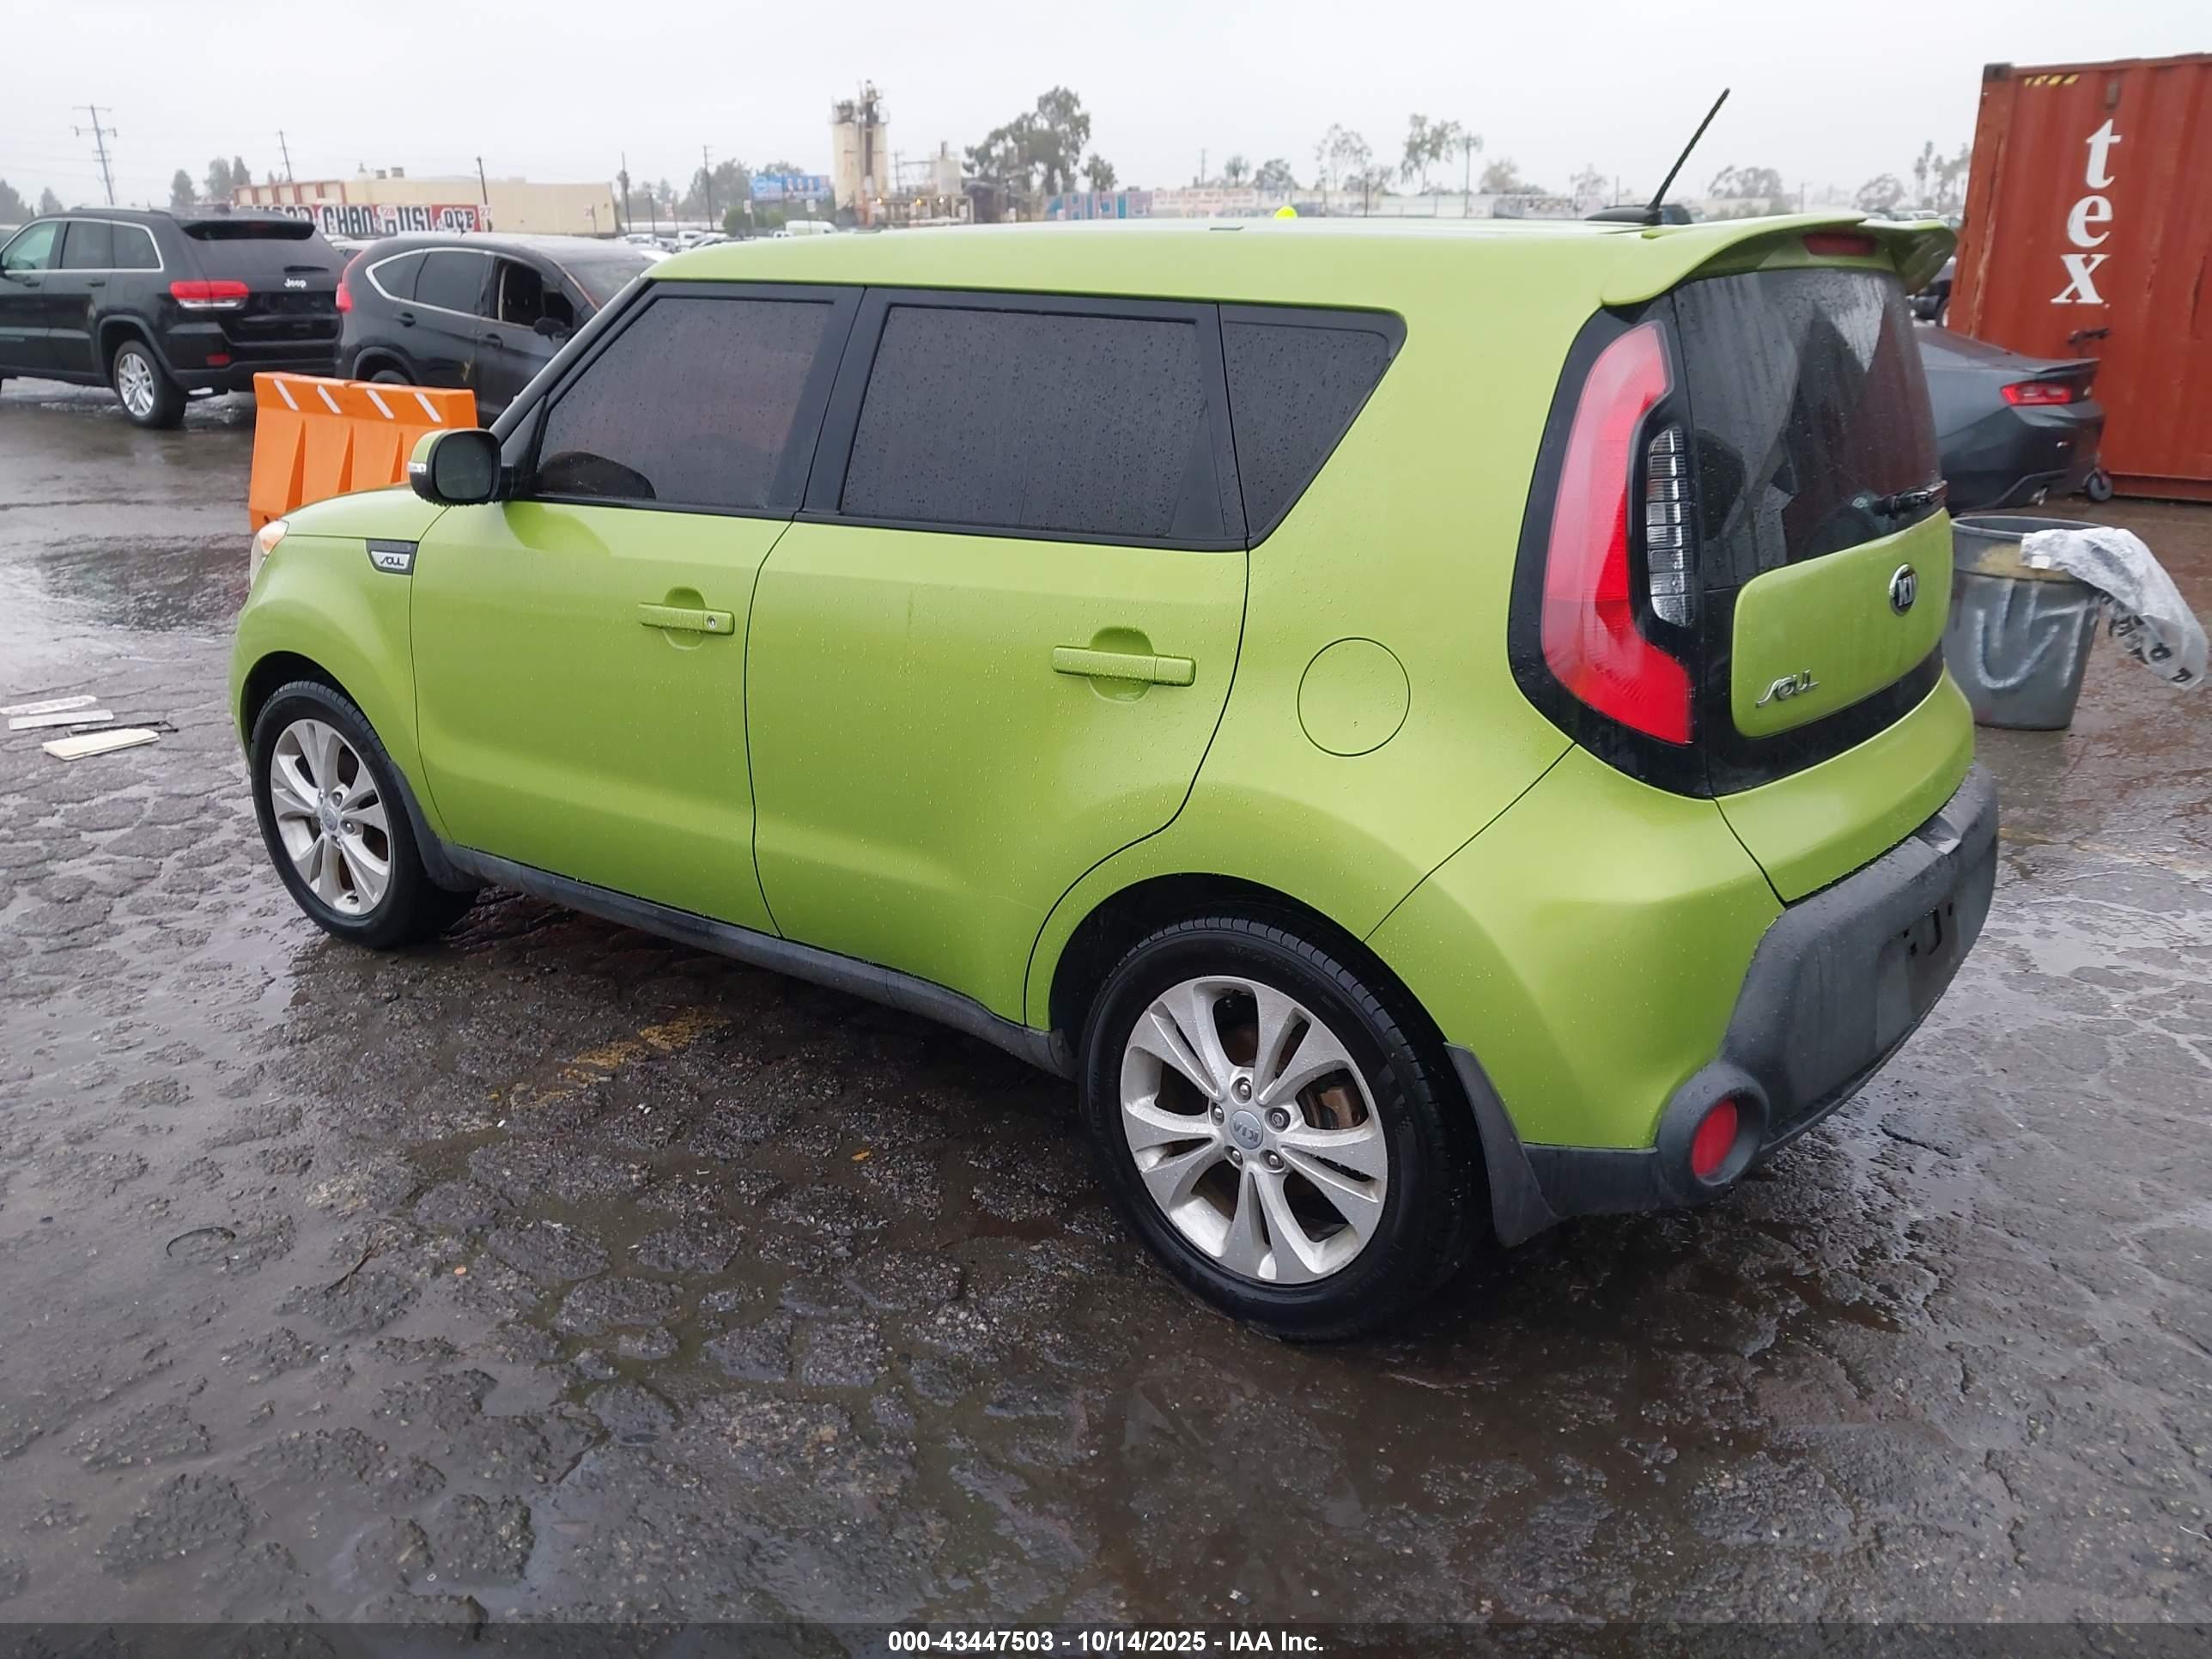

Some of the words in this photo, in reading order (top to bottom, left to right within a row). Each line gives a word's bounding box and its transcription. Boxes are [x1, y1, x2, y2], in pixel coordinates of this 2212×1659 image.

[2051, 118, 2123, 305] tex
[284, 278, 307, 289] Jeep
[1755, 669, 1820, 708] SOUL
[1233, 1122, 1259, 1143] KIA
